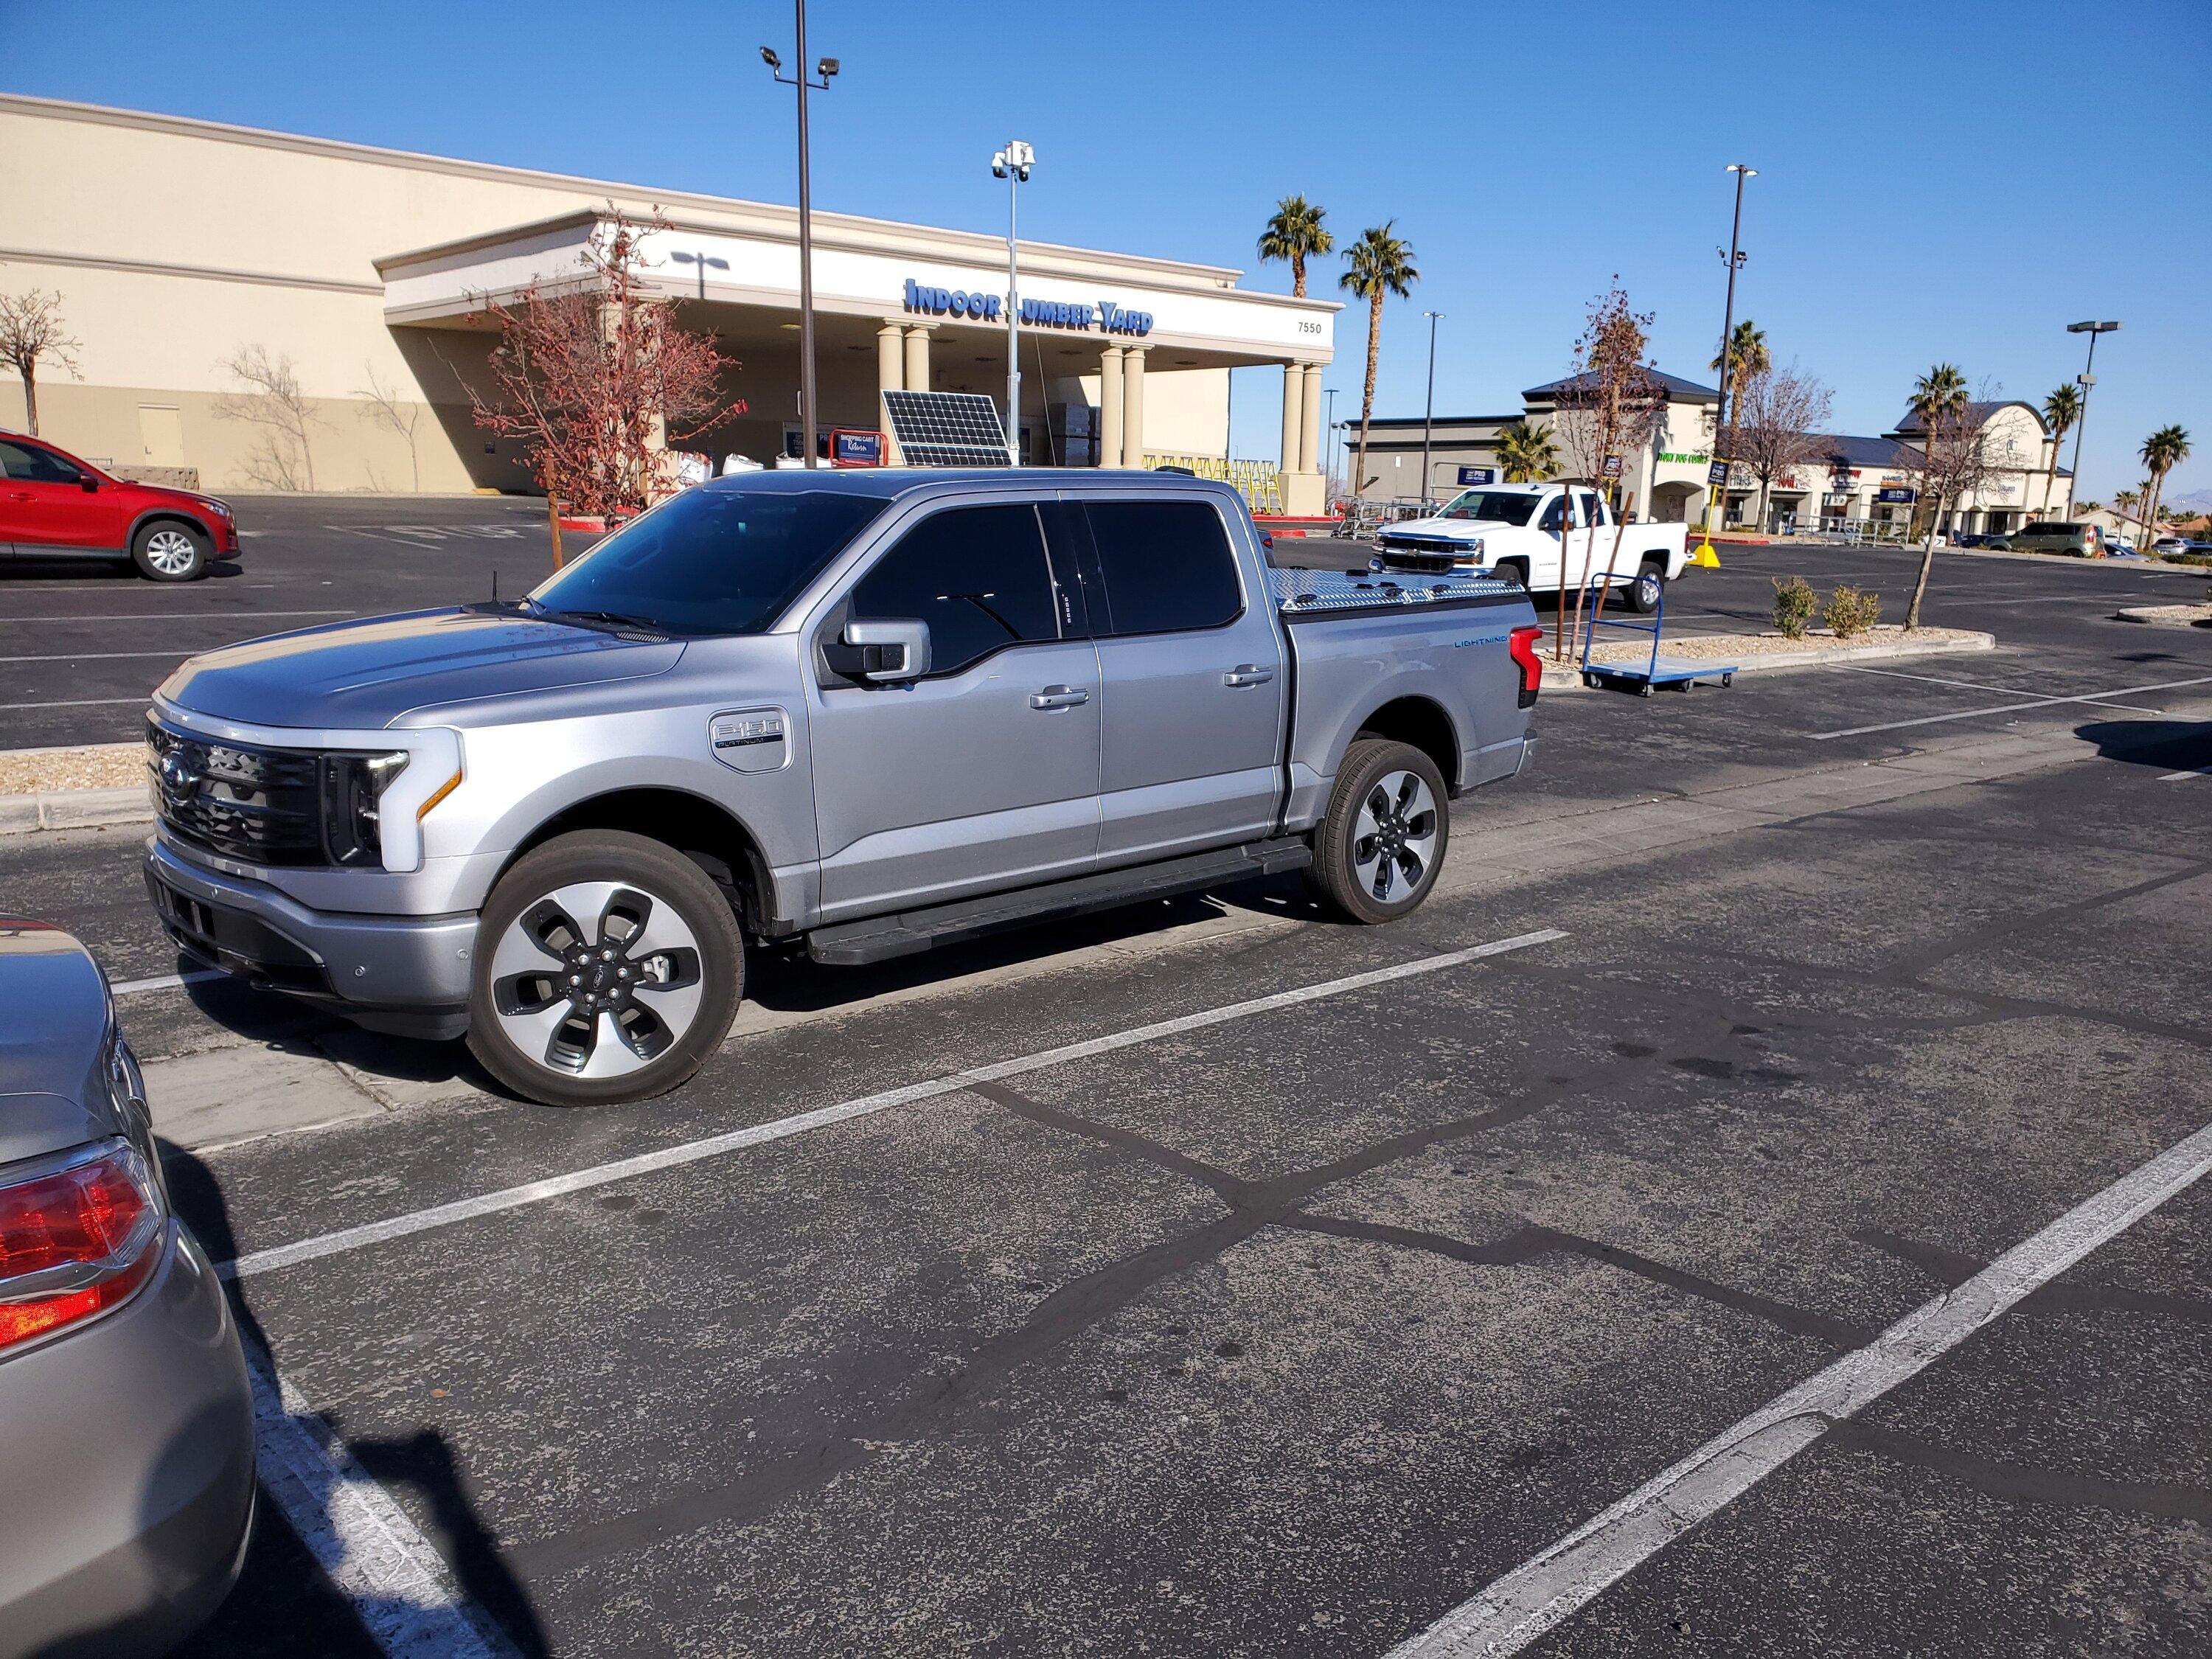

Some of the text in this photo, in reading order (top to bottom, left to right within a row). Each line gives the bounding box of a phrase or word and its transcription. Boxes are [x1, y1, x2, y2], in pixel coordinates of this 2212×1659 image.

[905, 278, 1153, 331] INDOOR UMBER YARD
[1298, 321, 1321, 334] 7550
[1454, 636, 1508, 647] LIGHTNING
[712, 720, 782, 740] F-150
[718, 737, 764, 747] PLATINUM
